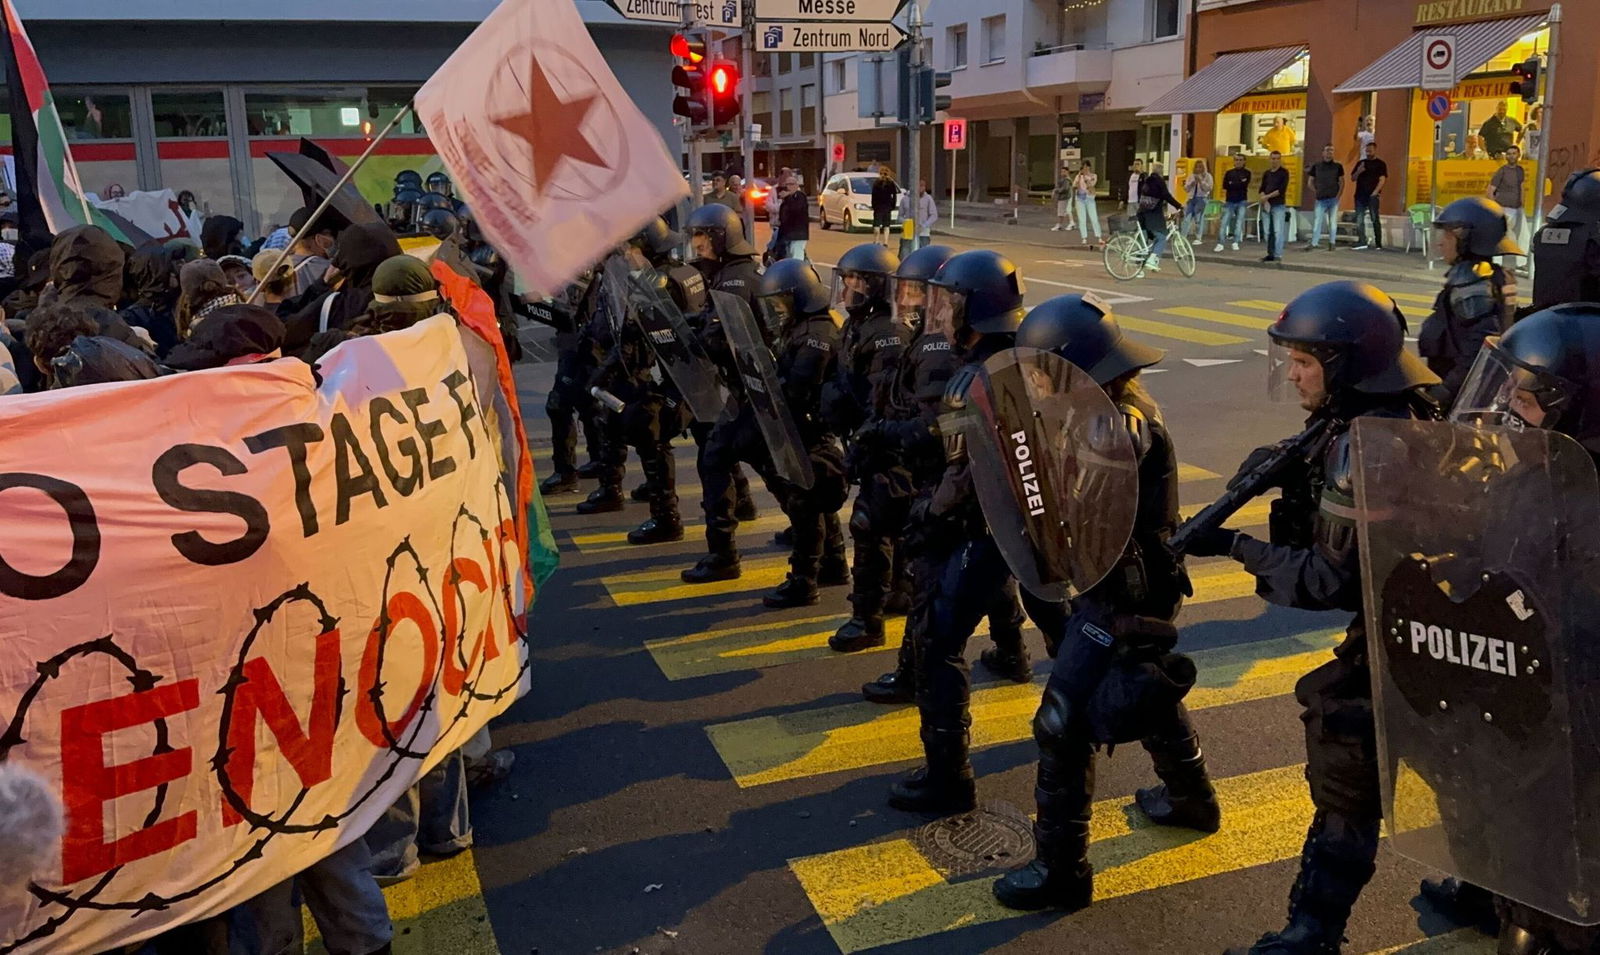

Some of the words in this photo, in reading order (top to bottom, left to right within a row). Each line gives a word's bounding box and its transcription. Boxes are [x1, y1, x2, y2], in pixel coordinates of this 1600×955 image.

[627, 0, 679, 17] Zentrum
[799, 0, 855, 14] Messe
[1415, 0, 1523, 23] RESTAURANT
[793, 27, 852, 47] Zentrum
[859, 28, 889, 47] Nord
[526, 303, 553, 321] POLIZEI
[806, 338, 831, 352] POLIZEI
[874, 336, 901, 350] POLIZEI
[151, 386, 457, 567] STAGE
[1010, 430, 1046, 517] POLIZEI
[1409, 621, 1517, 678] POLIZEI
